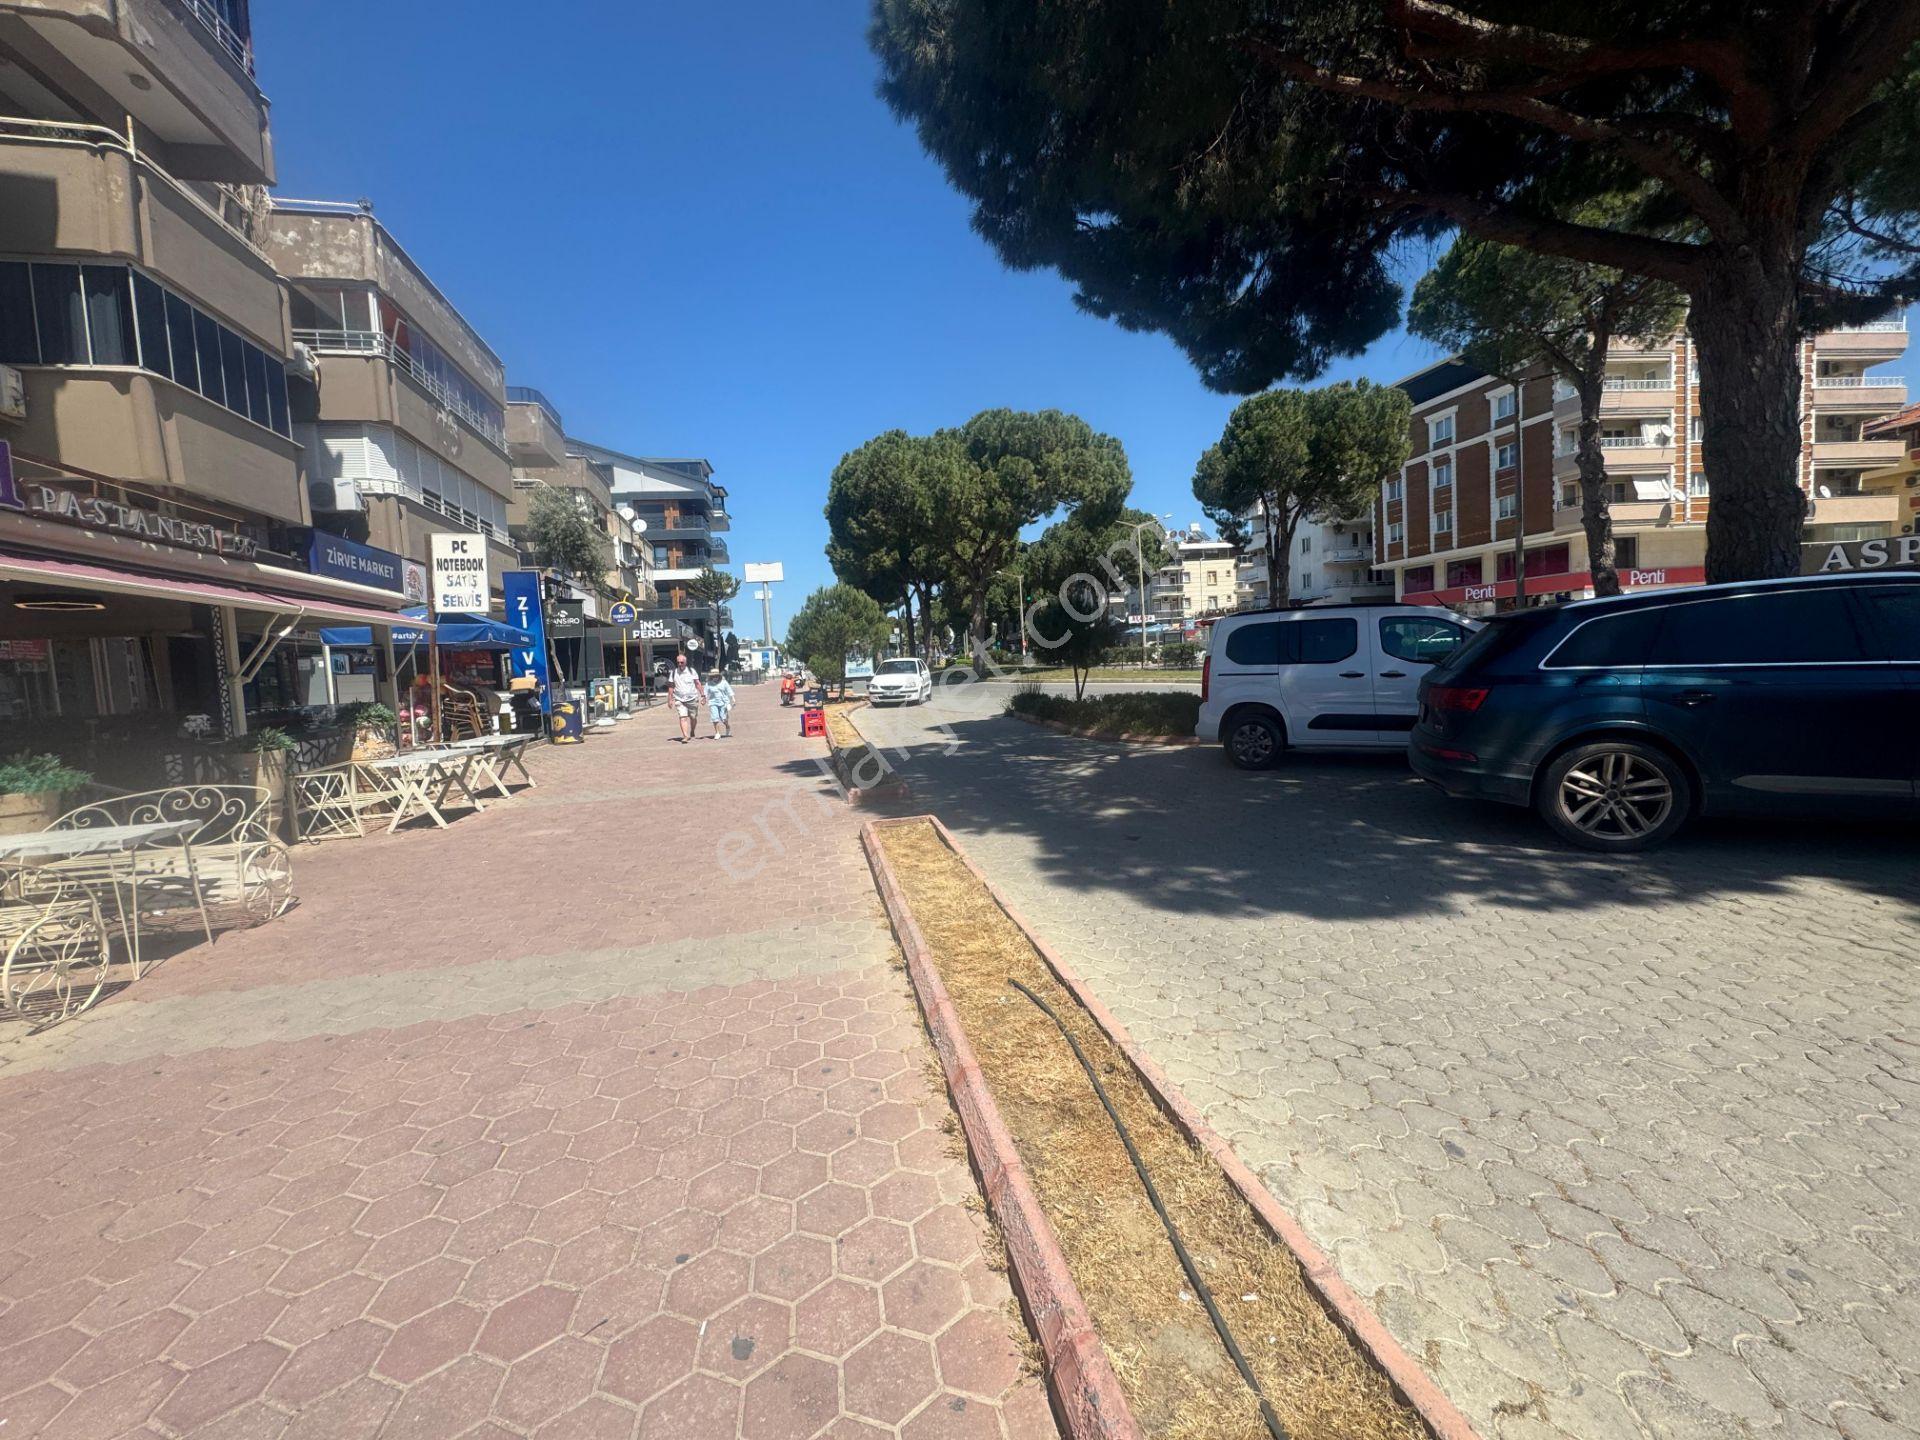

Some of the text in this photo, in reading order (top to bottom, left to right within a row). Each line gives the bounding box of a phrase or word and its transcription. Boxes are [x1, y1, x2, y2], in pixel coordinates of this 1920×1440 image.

[451, 540, 467, 554] PC
[326, 547, 394, 579] ZİRVE MARKET
[436, 558, 484, 571] NOTEBOOK
[1630, 570, 1665, 585] Penti
[1465, 585, 1496, 600] Penti
[517, 597, 536, 678] ZİVE
[632, 629, 672, 639] PERDE
